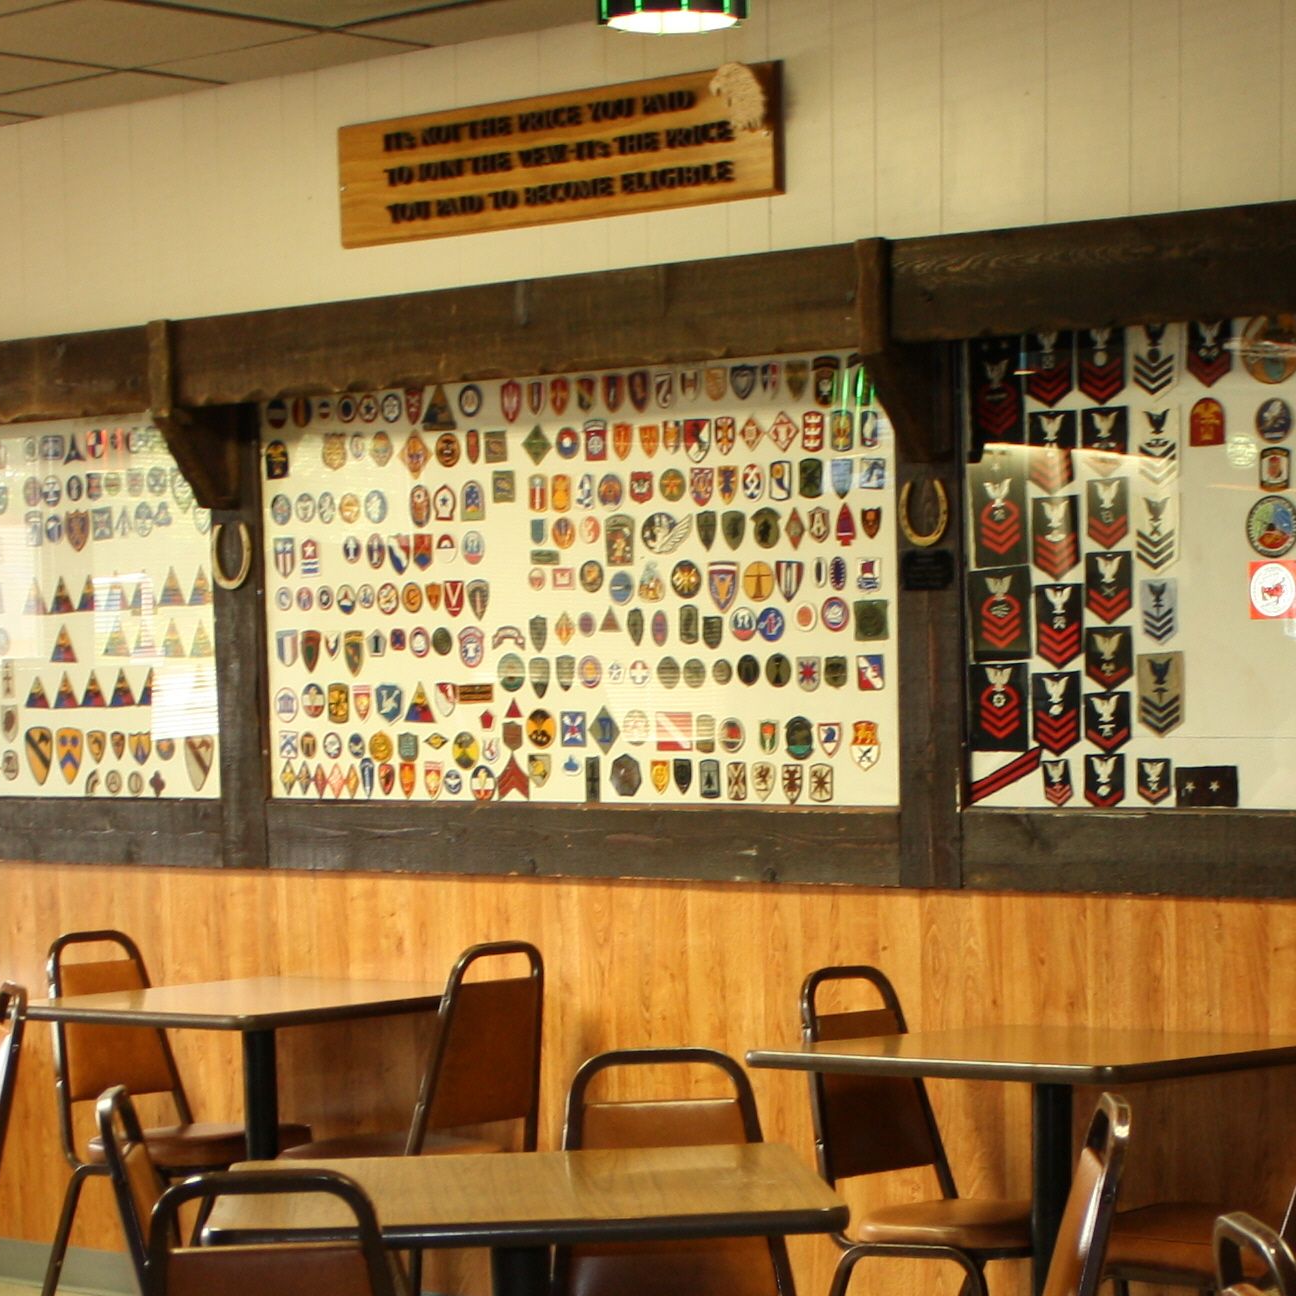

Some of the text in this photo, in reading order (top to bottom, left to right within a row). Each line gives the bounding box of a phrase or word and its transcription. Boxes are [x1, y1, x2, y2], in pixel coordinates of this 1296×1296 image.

[421, 124, 463, 146] NOT
[464, 116, 513, 140] THE
[518, 105, 583, 133] PRICE
[588, 97, 636, 122] YOU
[642, 90, 697, 116] PAID
[384, 166, 415, 187] TO
[417, 158, 464, 182] JOIN
[465, 152, 513, 175] THE
[613, 132, 660, 155] THE
[665, 120, 736, 149] PRICE
[386, 161, 736, 224] YOU PAID TO BECOME ELIGIBLE
